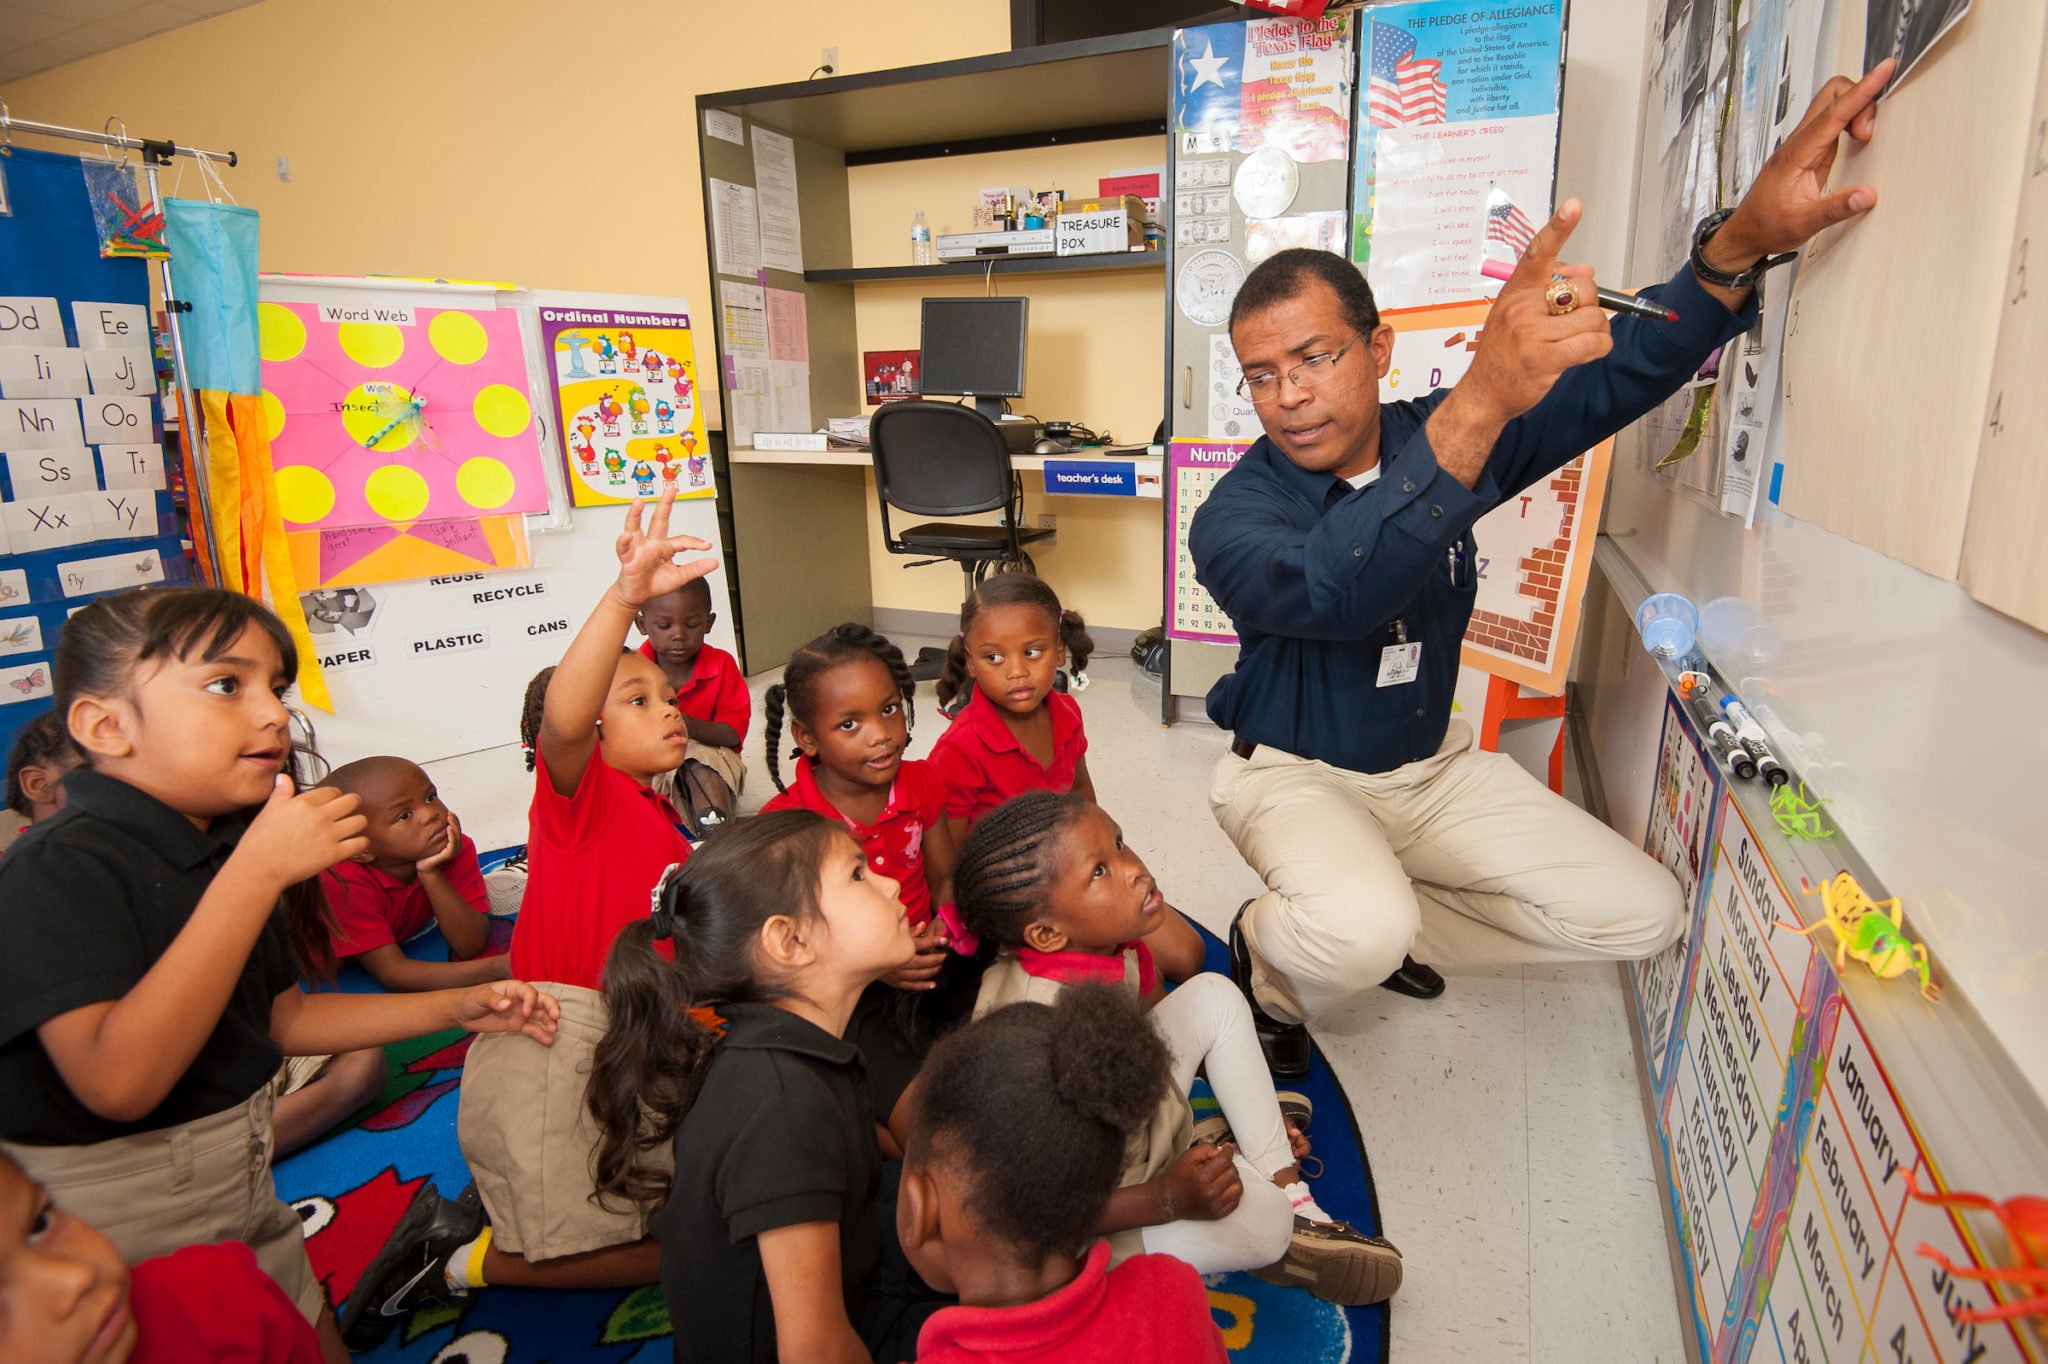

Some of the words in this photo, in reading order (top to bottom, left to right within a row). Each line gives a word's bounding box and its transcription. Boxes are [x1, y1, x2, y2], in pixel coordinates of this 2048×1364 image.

[1407, 18, 1426, 29] THE
[1429, 14, 1467, 27] PLEDGE
[1471, 12, 1486, 23] OF
[1488, 4, 1555, 21] ALLEGIANCE
[1249, 22, 1295, 41] Pledge
[1298, 21, 1312, 34] to
[1318, 16, 1338, 31] the
[1464, 25, 1489, 36] pledge
[1491, 21, 1528, 33] allegiance
[1256, 39, 1297, 54] Texas
[1301, 34, 1333, 49] Flag
[1483, 34, 1495, 42] the
[1496, 33, 1511, 44] flag
[1437, 49, 1445, 57] of
[1446, 47, 1458, 56] the
[1459, 45, 1483, 55] United
[1484, 43, 1506, 53] States
[1507, 42, 1515, 50] of
[1517, 39, 1550, 50] America,
[1458, 56, 1472, 65] and
[1473, 55, 1482, 63] to
[1483, 54, 1495, 62] the
[1496, 51, 1527, 62] Republic
[1457, 66, 1469, 75] for
[1470, 64, 1491, 73] which
[1493, 63, 1499, 71] it
[1500, 61, 1526, 71] stands,
[1466, 75, 1490, 84] nation
[1491, 72, 1513, 81] under
[1514, 70, 1532, 80] God,
[1471, 83, 1509, 94] indivisible,
[1469, 95, 1485, 103] with
[1487, 93, 1511, 104] liberty
[1456, 106, 1471, 114] and
[1472, 103, 1496, 115] justice
[1496, 102, 1508, 112] for
[1433, 129, 1476, 139] LEARNER'S
[1061, 217, 1120, 232] TREASURE
[1061, 238, 1086, 249] BOX
[100, 311, 129, 335] Ee
[326, 307, 369, 321] Word
[374, 308, 408, 322] Web
[543, 311, 609, 324] Ordinal
[614, 314, 687, 327] Numbers
[34, 355, 51, 380] Ii
[115, 356, 136, 391] Jj
[1389, 368, 1400, 388] C
[1430, 368, 1442, 388] D
[102, 403, 138, 427] Oo
[329, 400, 380, 413] Insect
[18, 407, 55, 433] Nn
[39, 458, 71, 481] Ss
[126, 452, 146, 474] Tt
[1057, 473, 1099, 484] teacher's
[1101, 474, 1123, 484] desk
[1196, 472, 1201, 481] 2
[1210, 473, 1215, 481] 3
[1182, 489, 1187, 497] 11
[1195, 489, 1202, 498] 12
[107, 498, 138, 531] Yy
[1180, 505, 1187, 514] 21
[1520, 496, 1532, 518] T
[27, 505, 69, 532] Xx
[1180, 522, 1187, 530] 31
[1180, 538, 1187, 547] 41
[1179, 571, 1186, 579] 61
[1477, 558, 1490, 579] Z
[67, 574, 84, 590] fly
[472, 583, 545, 604] RECYCLE
[1178, 587, 1186, 595] 71
[1192, 588, 1200, 596] 72
[1178, 603, 1185, 611] 81
[1191, 604, 1199, 612] 82
[1204, 605, 1213, 613] 83
[527, 619, 568, 636] CANS
[1178, 619, 1185, 627] 91
[1190, 620, 1199, 628] 92
[1204, 621, 1213, 629] 93
[1217, 622, 1226, 630] 94
[413, 633, 484, 653] PLASTIC
[1674, 851, 1681, 867] 7
[1737, 837, 1780, 942] Sunday
[1726, 885, 1770, 1003] Monday
[1718, 934, 1761, 1062] Tuesday
[1703, 967, 1759, 1146] Wednesday
[1698, 1030, 1738, 1177] Thursday
[1839, 1044, 1898, 1185] January
[1690, 1096, 1718, 1204] Friday
[1676, 1125, 1711, 1278] Saturday
[1814, 1113, 1875, 1281] February
[1803, 1211, 1844, 1344] March
